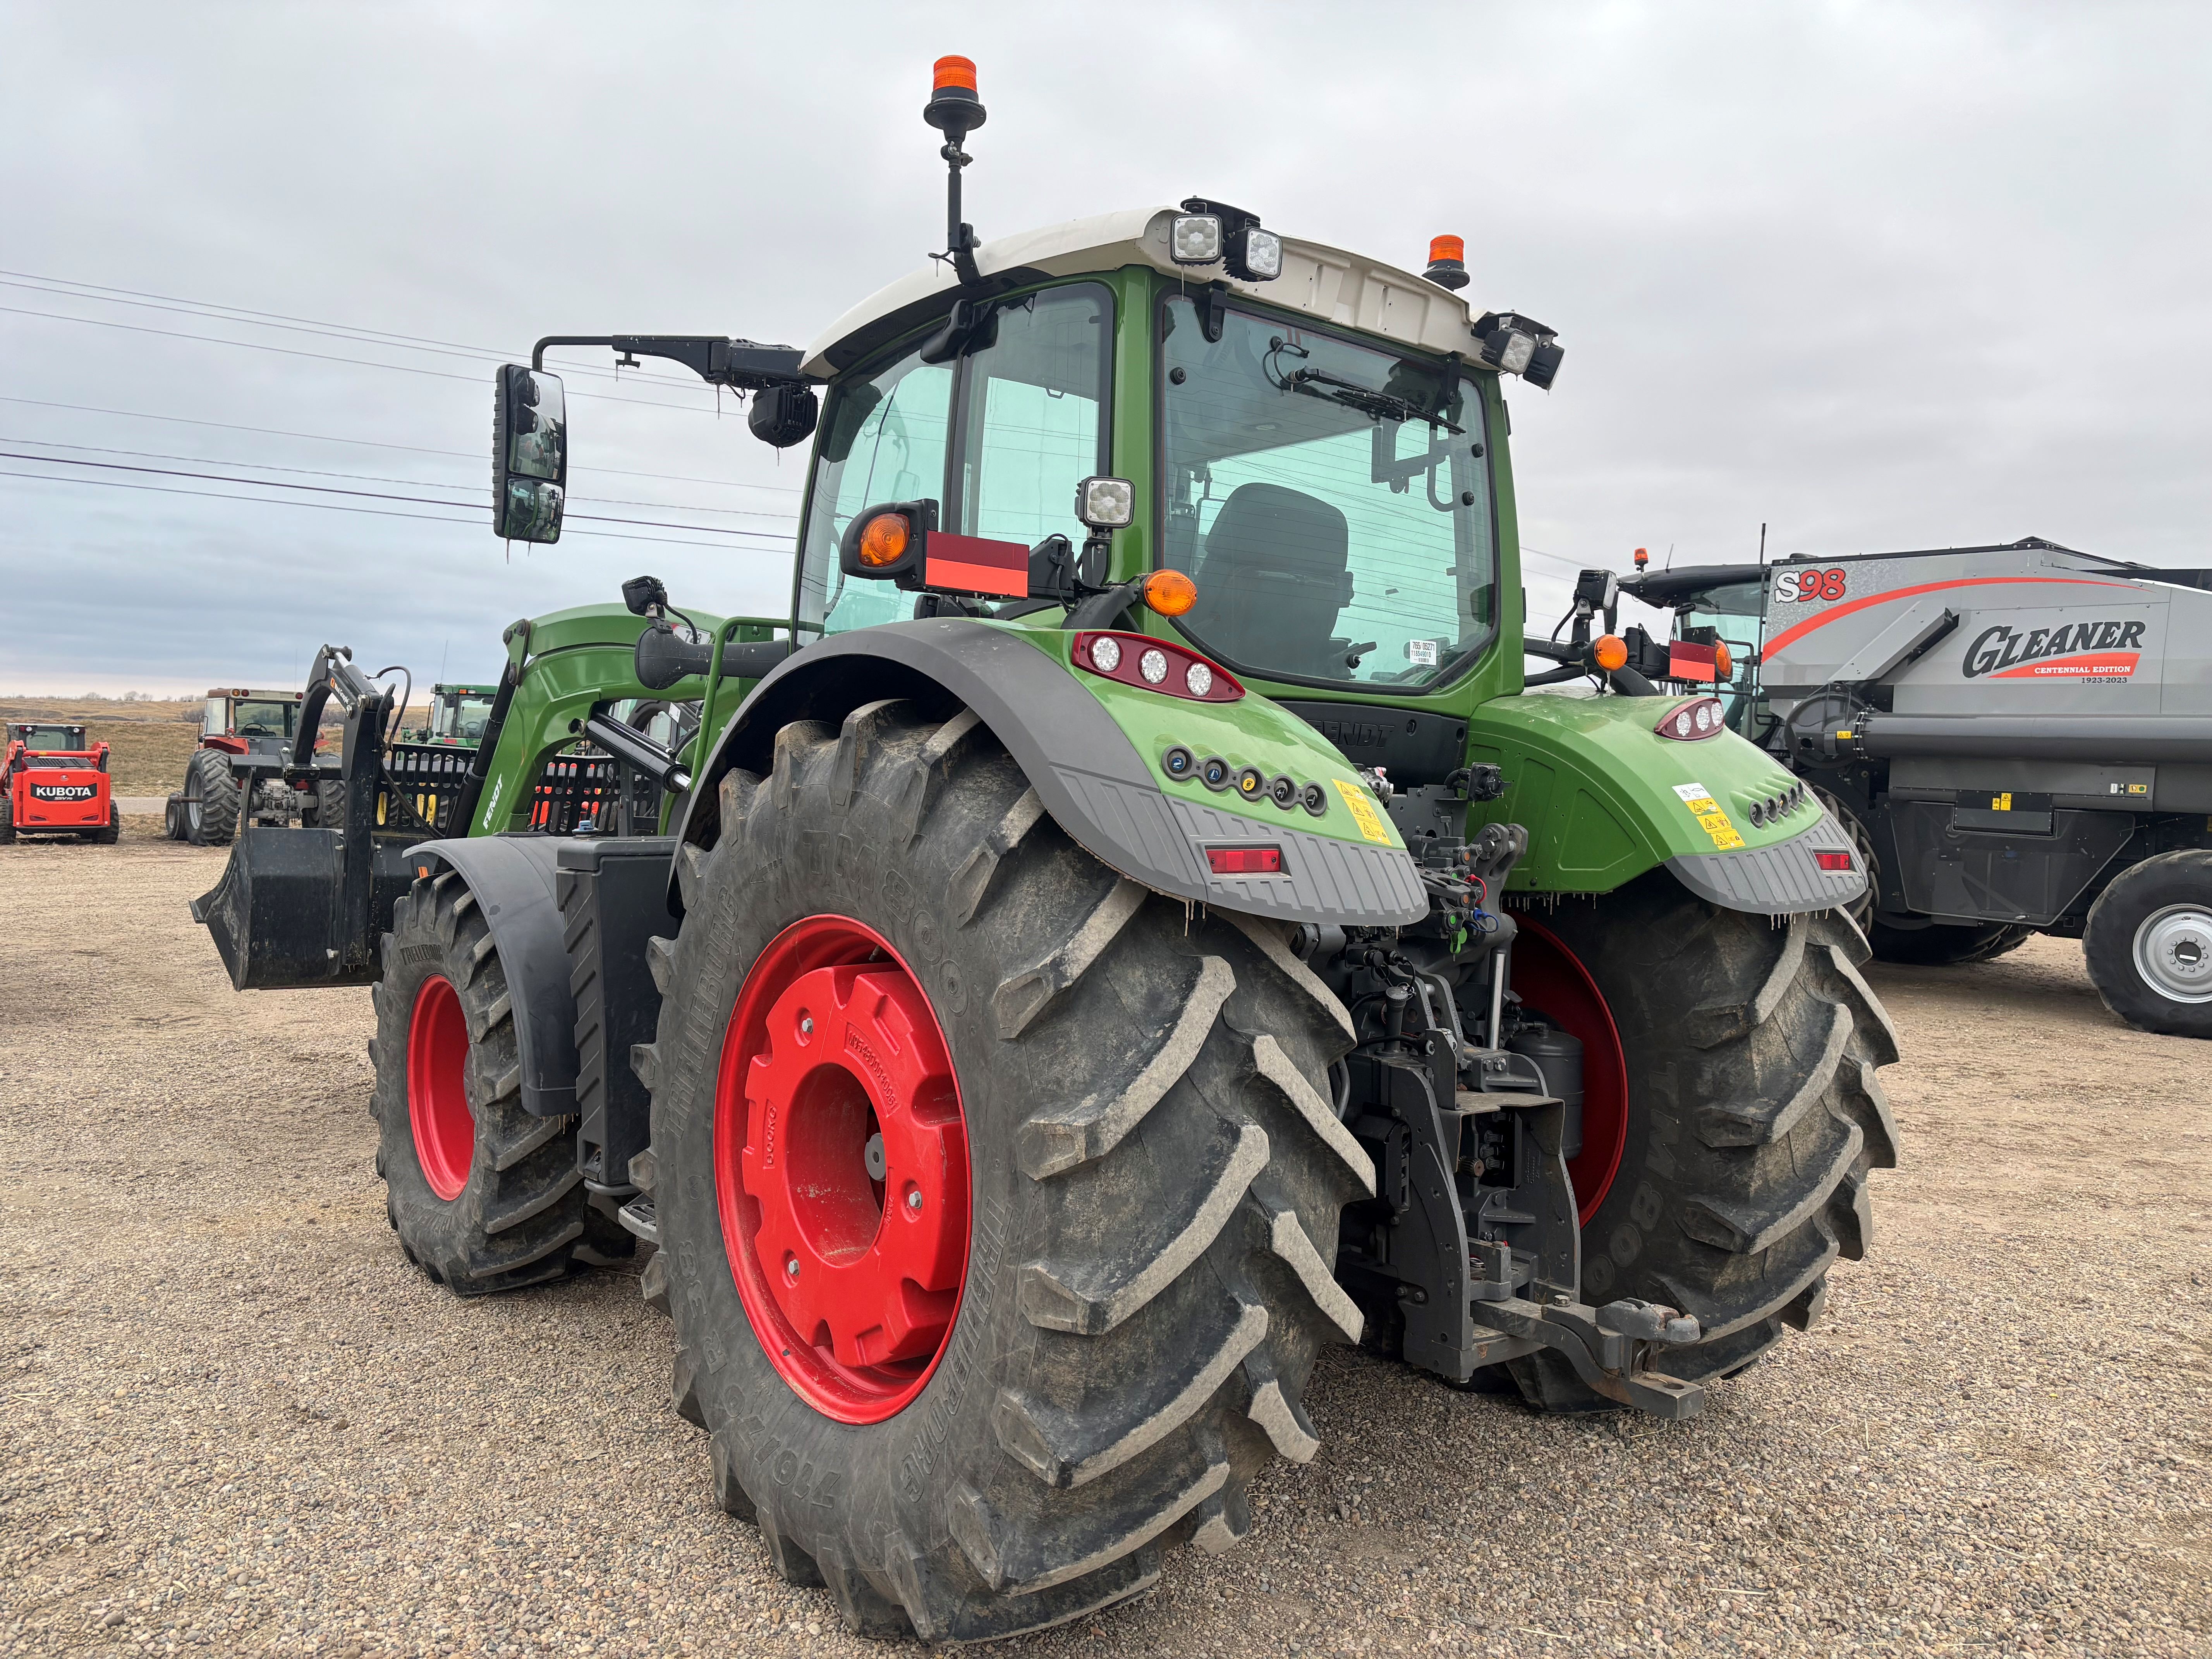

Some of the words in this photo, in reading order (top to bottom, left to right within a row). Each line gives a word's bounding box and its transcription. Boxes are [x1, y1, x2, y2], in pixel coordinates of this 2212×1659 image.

[1774, 568, 1846, 603] S98
[1962, 621, 2146, 678] GLEANER
[36, 787, 92, 797] KUBOTA
[483, 773, 503, 830] FENDT
[661, 886, 739, 1140] TRELLEBORG
[899, 1196, 1013, 1503] TRELLEBORG
